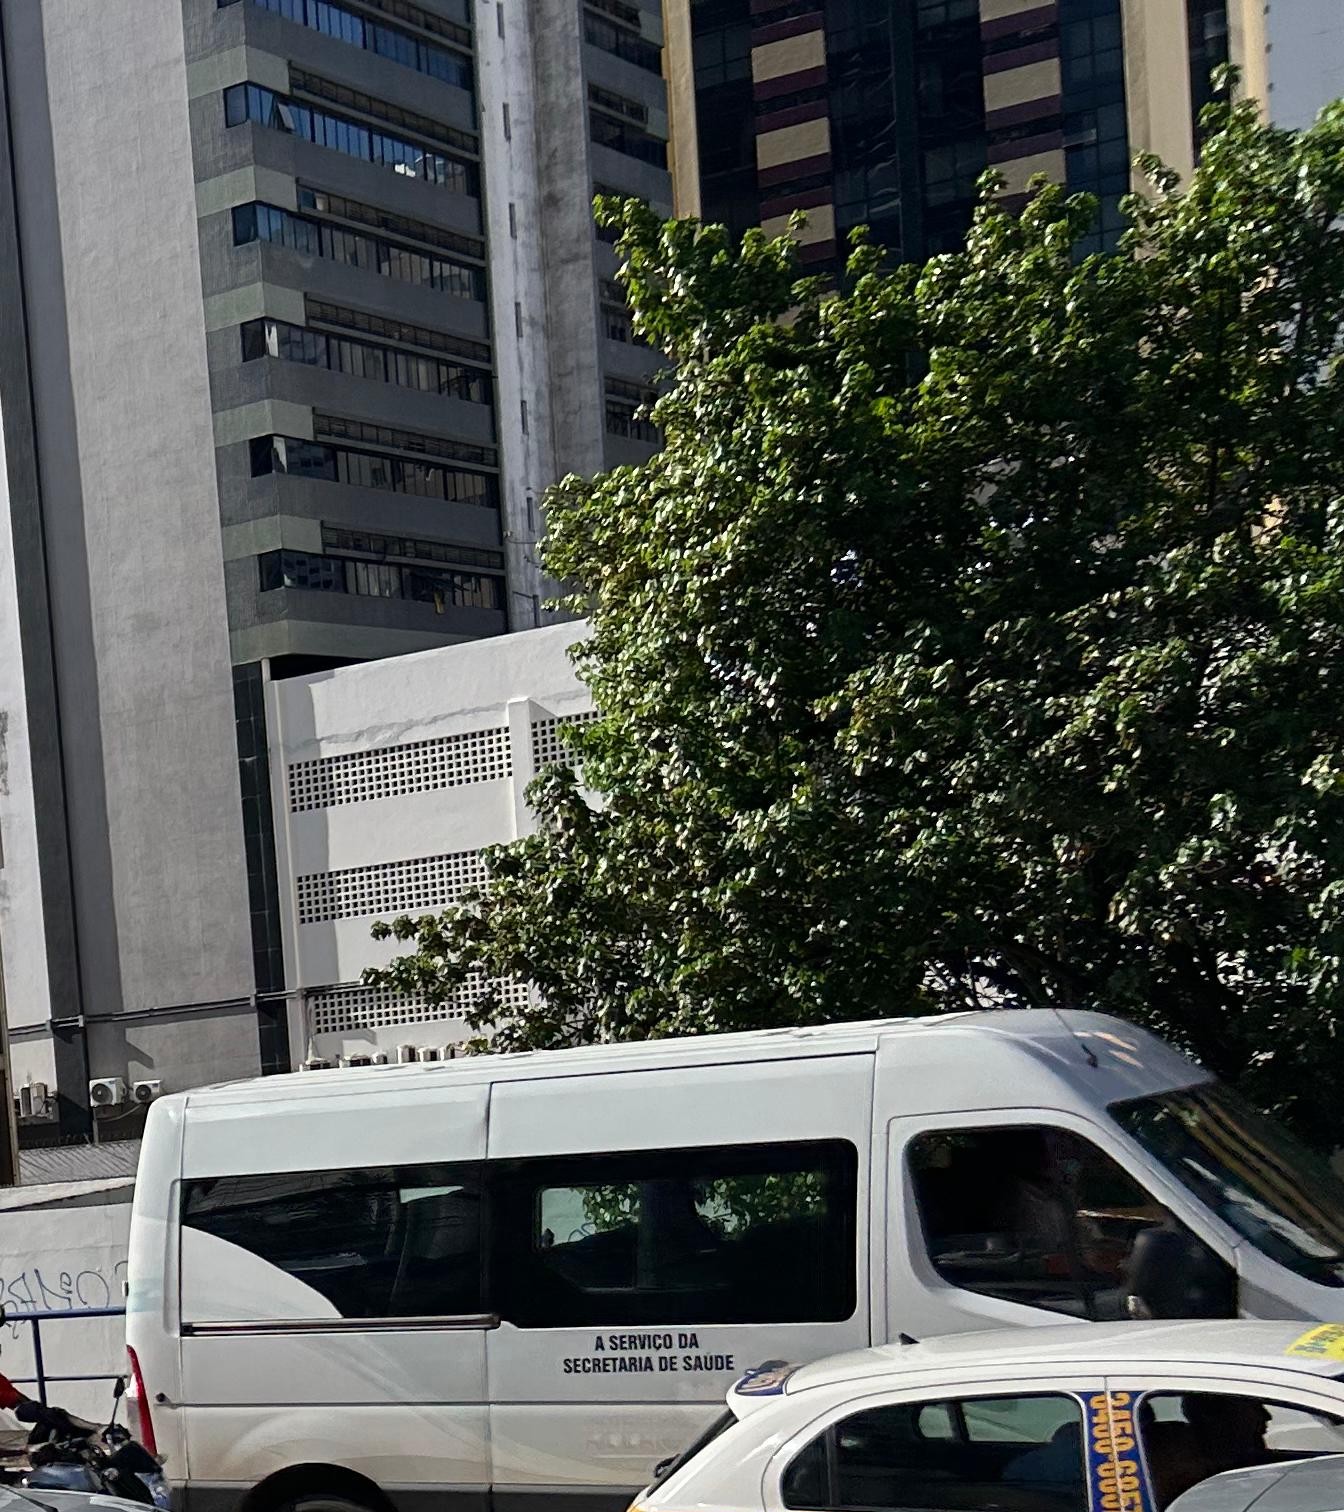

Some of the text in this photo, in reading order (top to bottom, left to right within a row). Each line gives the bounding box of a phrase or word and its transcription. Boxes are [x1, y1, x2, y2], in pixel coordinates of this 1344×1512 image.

[595, 1333, 699, 1352] A SERVIÇO DA
[563, 1356, 654, 1374] SECRETARIA
[658, 1356, 678, 1372] DE
